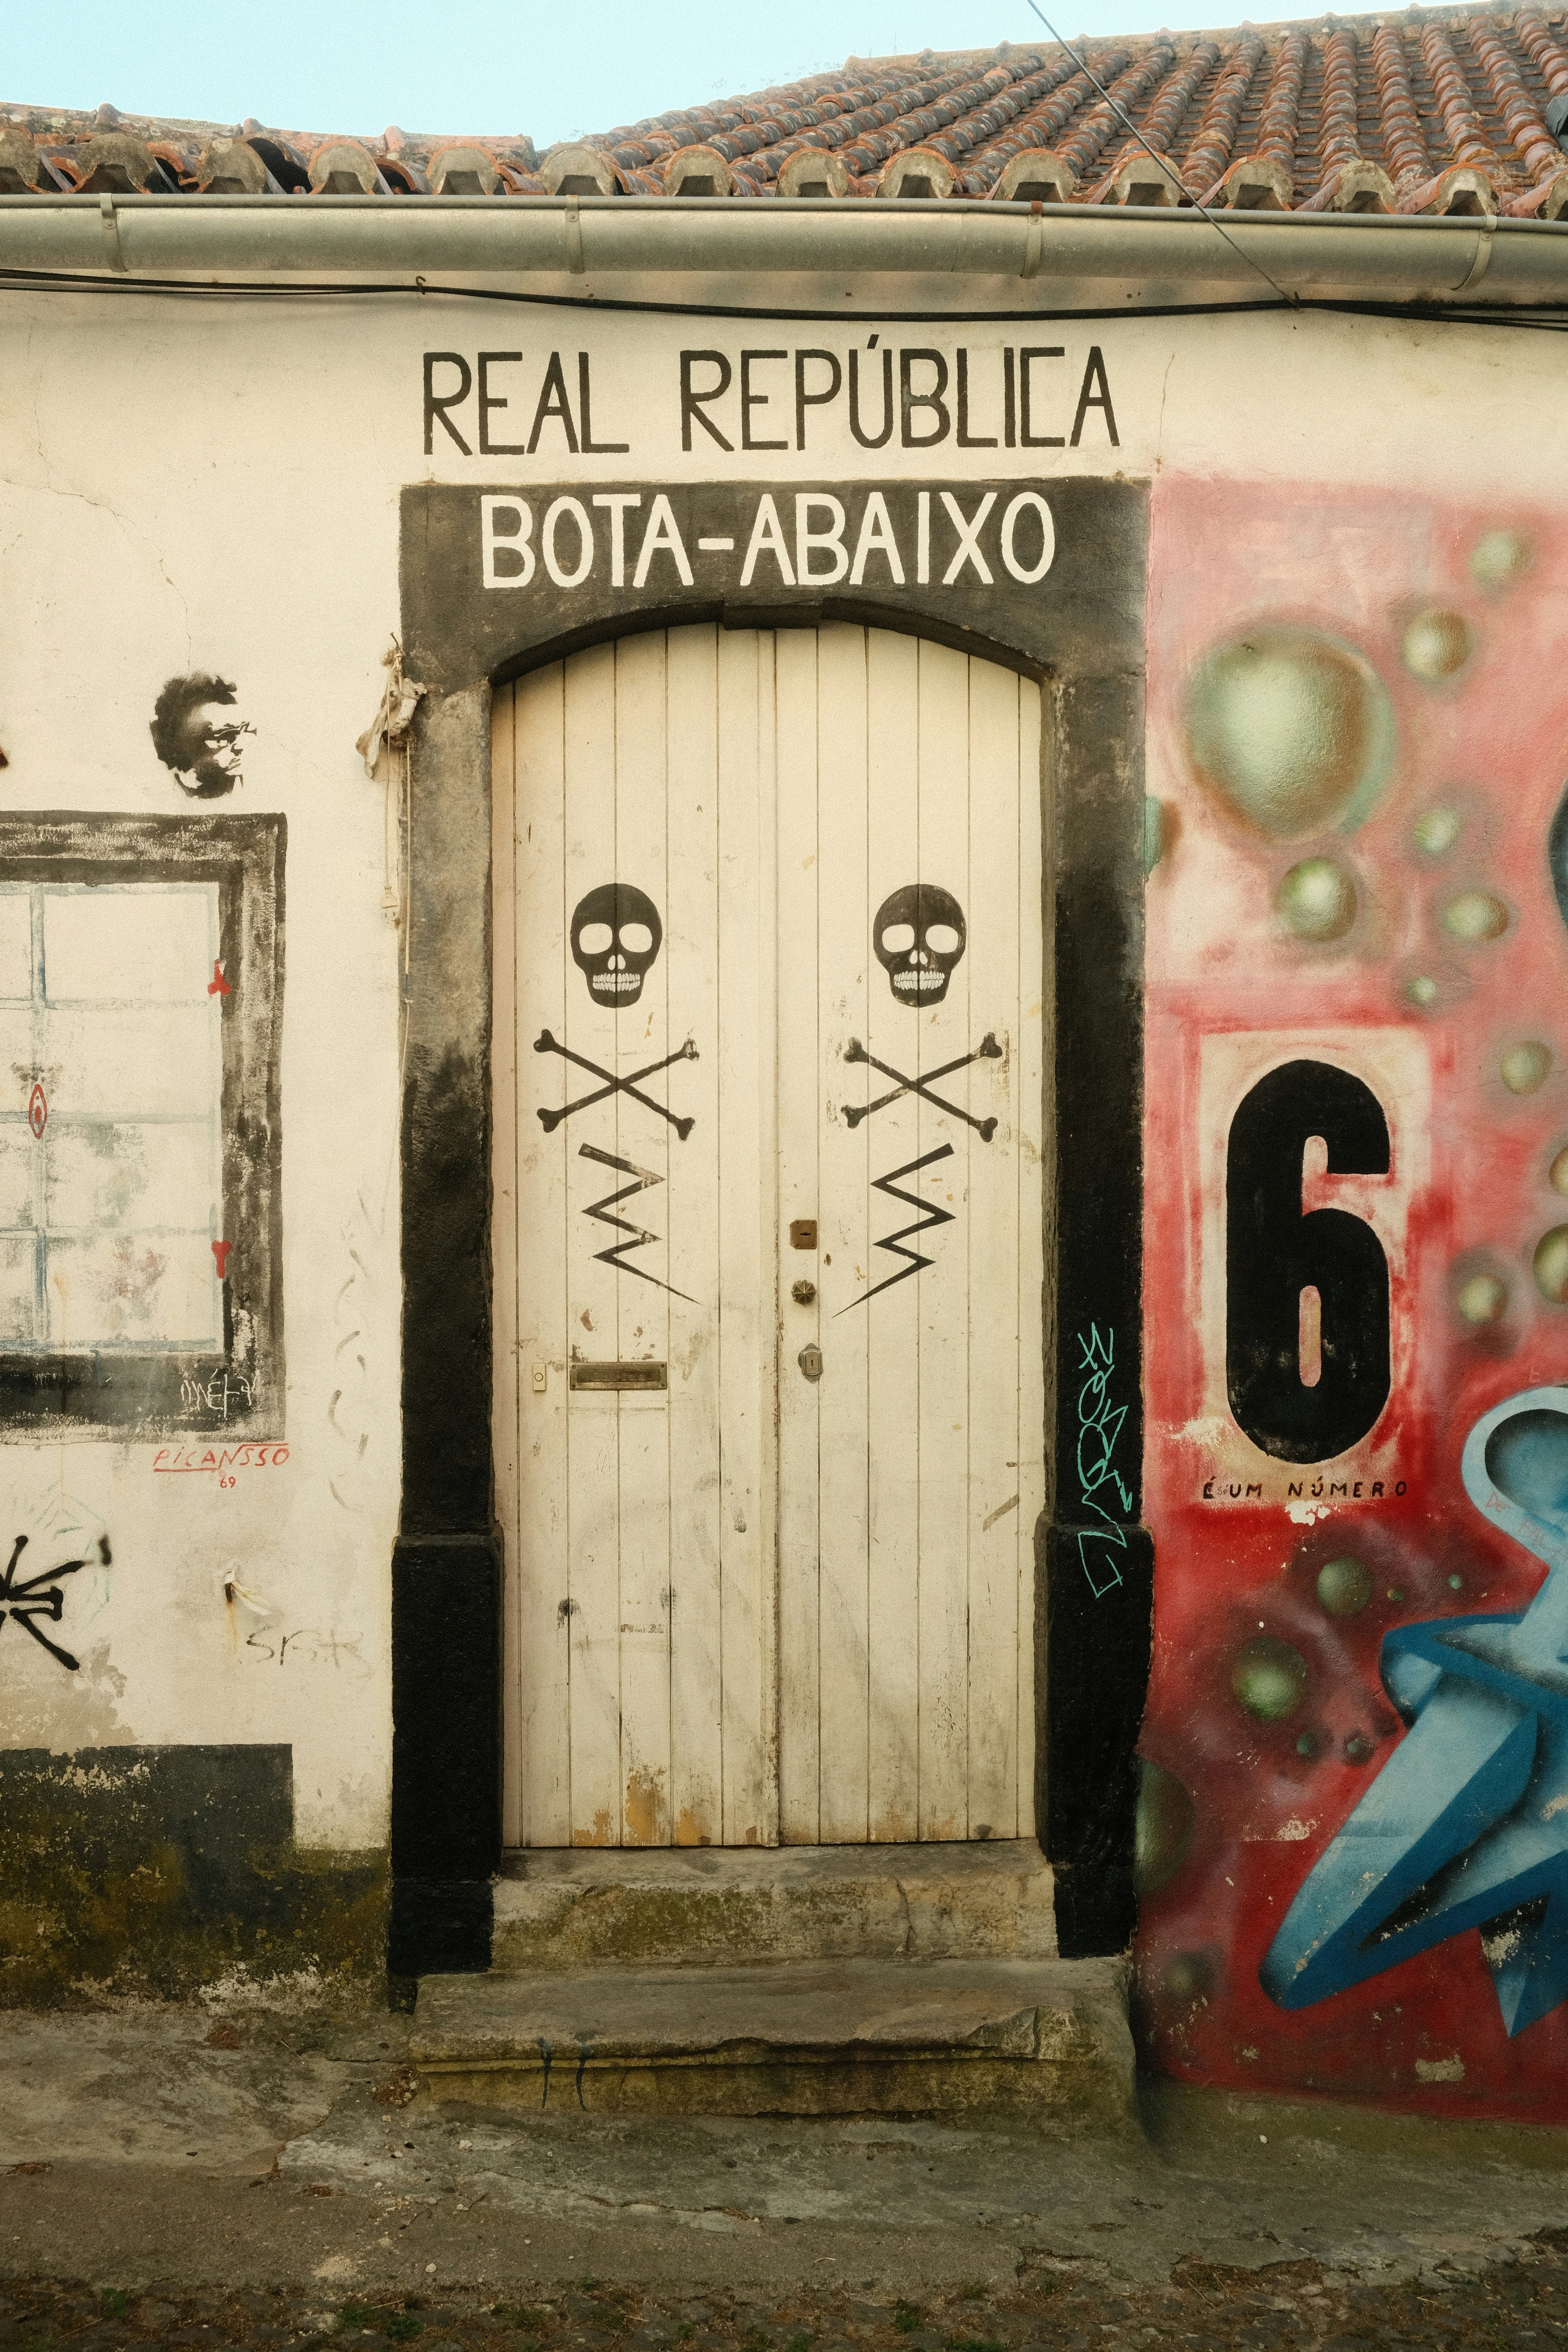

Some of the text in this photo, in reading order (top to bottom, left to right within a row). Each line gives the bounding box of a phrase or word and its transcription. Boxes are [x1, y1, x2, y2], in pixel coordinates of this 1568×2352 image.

[423, 334, 1120, 456] REAL REPÚBLICA
[481, 492, 1055, 589] BOTA-ABAIXO
[1226, 1060, 1390, 1464] 6
[220, 1476, 236, 1488] 69
[1203, 1476, 1216, 1499] É
[1230, 1484, 1263, 1498] UM
[1288, 1476, 1407, 1498] NÚMERO
